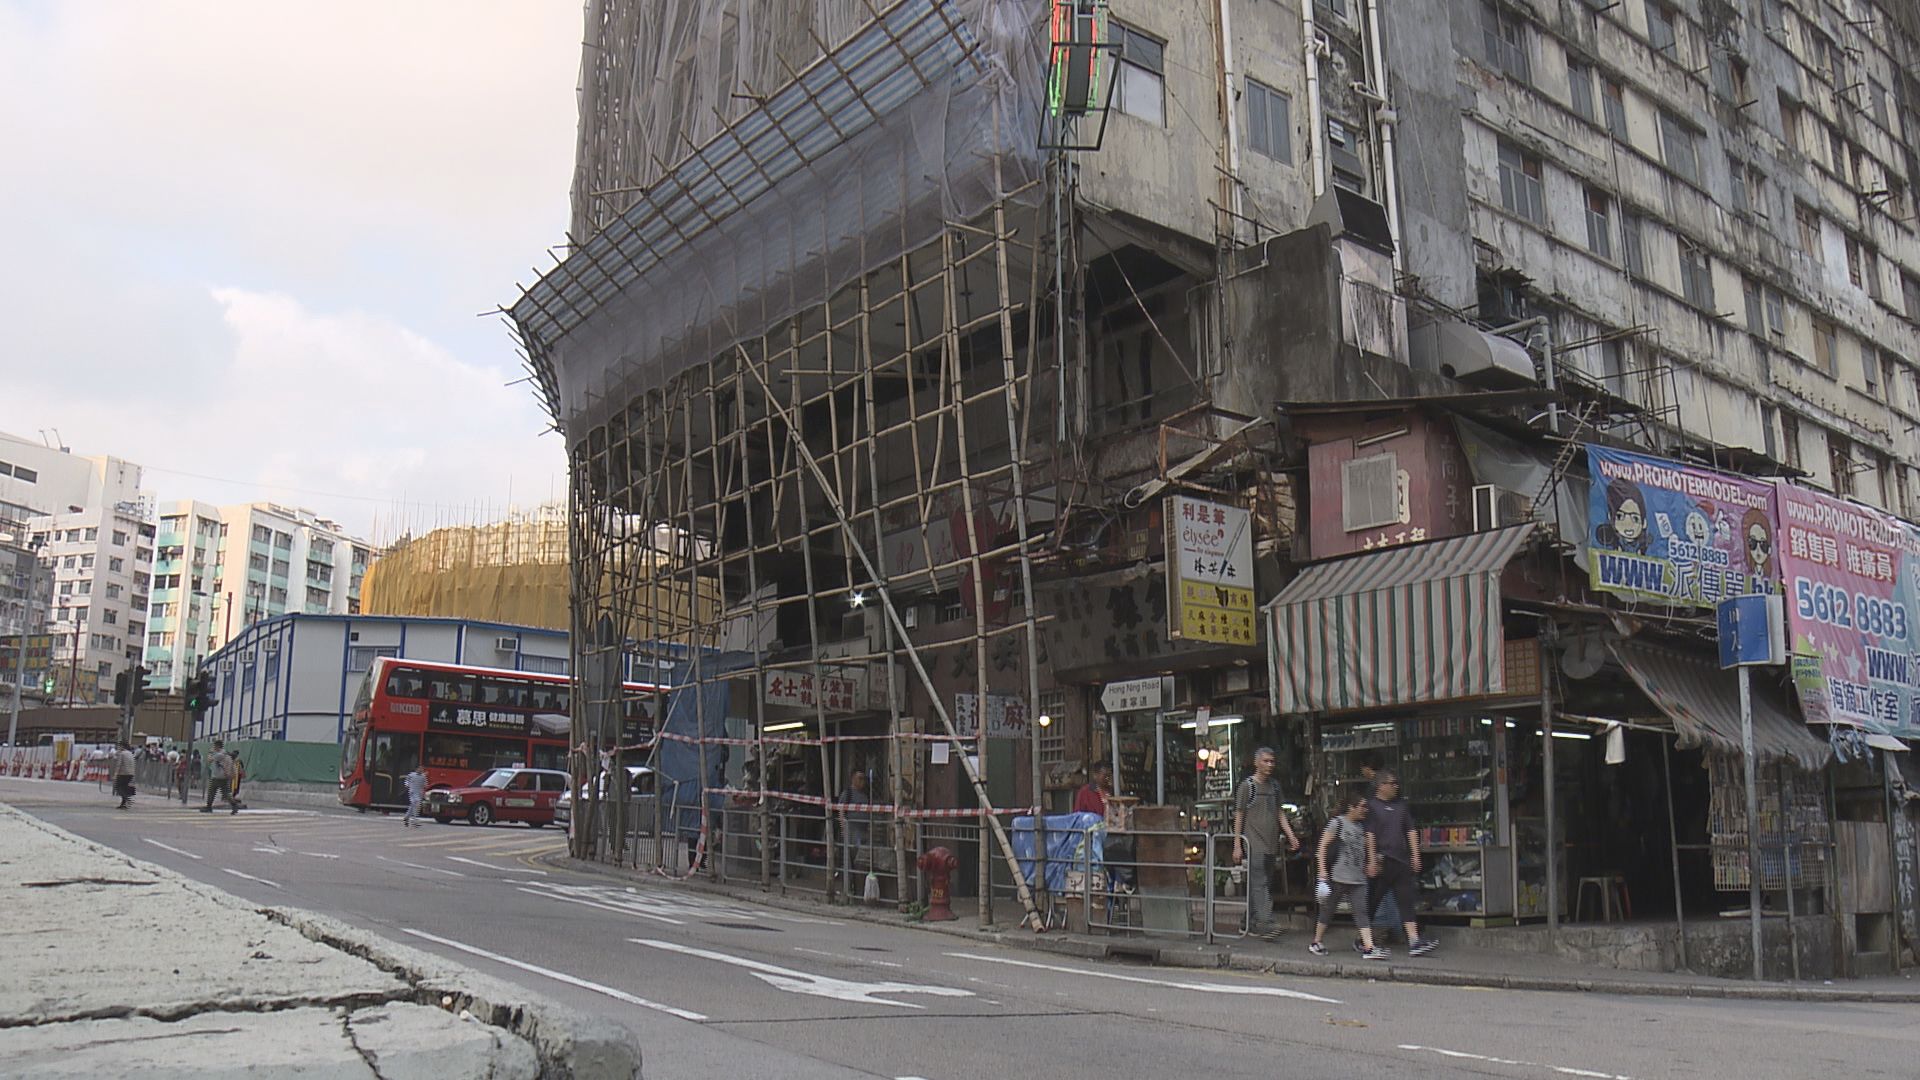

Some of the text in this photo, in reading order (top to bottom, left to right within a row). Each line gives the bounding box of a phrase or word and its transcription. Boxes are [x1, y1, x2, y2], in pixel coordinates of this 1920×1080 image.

[1600, 460, 1768, 510] www.PROMOTERMODEL.com
[1669, 541, 1728, 566] 5612 8883
[1791, 527, 1839, 569] 銷售員
[1847, 544, 1893, 582] 推廣員
[1796, 577, 1907, 640] 5612 8883
[1109, 680, 1160, 695] Hong Ning Road
[457, 709, 487, 727] 慕思
